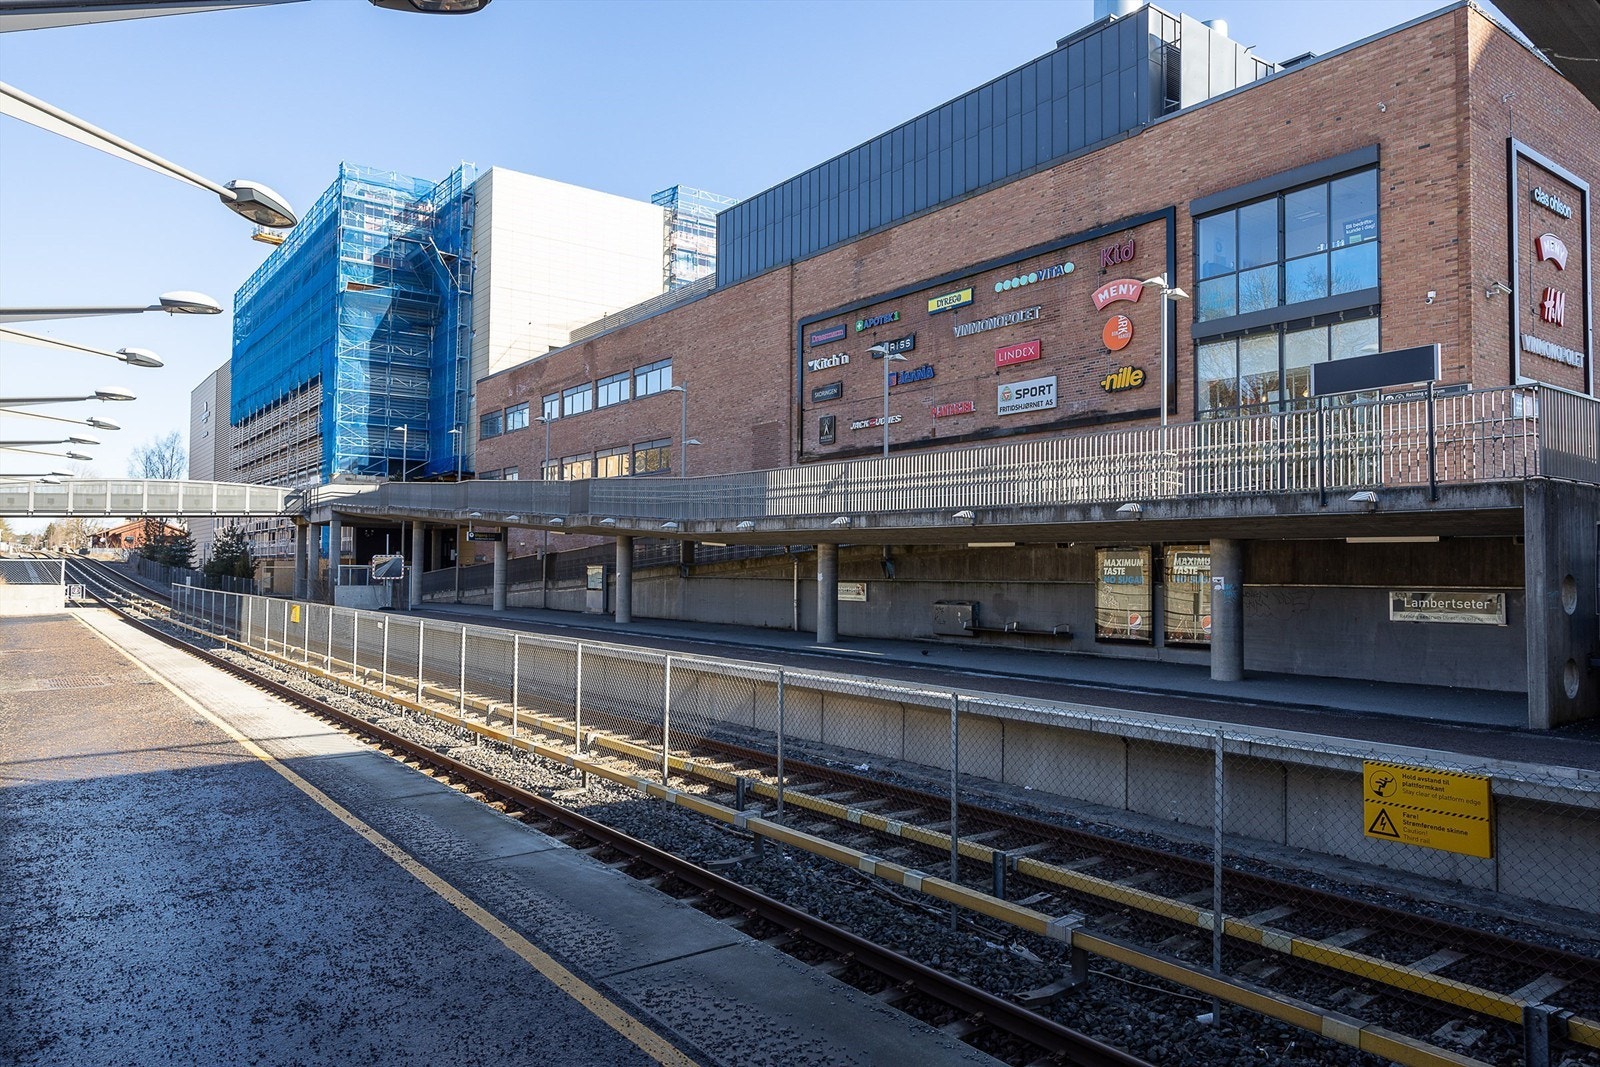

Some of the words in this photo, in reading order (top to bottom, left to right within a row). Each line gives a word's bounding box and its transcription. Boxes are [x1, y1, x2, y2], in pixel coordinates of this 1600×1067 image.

[1534, 187, 1549, 207] clas
[1550, 195, 1572, 219] ohlson
[1101, 239, 1135, 267] Kid
[1544, 241, 1565, 258] MENY
[1037, 264, 1064, 281] VITA
[1098, 283, 1137, 303] MENY
[1544, 286, 1565, 328] H&M
[953, 305, 1042, 338] VINMONOPOLET
[1117, 315, 1128, 335] ARK
[999, 345, 1035, 362] LINDEX
[1521, 333, 1585, 369] VINMONOPOLET
[1015, 384, 1054, 400] SPORT
[1045, 399, 1054, 407] AS
[850, 420, 870, 430] JACK
[1103, 558, 1144, 567] MAXIMUM
[1103, 567, 1125, 575] TASTE
[1173, 566, 1198, 575] TASTE
[1103, 575, 1116, 584] NO
[1404, 597, 1490, 610] Lambertseter
[1402, 781, 1445, 792] plattformkant
[1417, 776, 1442, 784] avstand
[1402, 788, 1414, 796] Stay
[1415, 790, 1430, 798] clear
[1438, 794, 1465, 803] platform
[1465, 798, 1482, 806] edge
[1402, 811, 1419, 820] Fare!
[1403, 826, 1428, 836] Caution!
[1446, 827, 1469, 836] skinne
[1403, 834, 1419, 842] Third
[1420, 837, 1431, 845] rail
